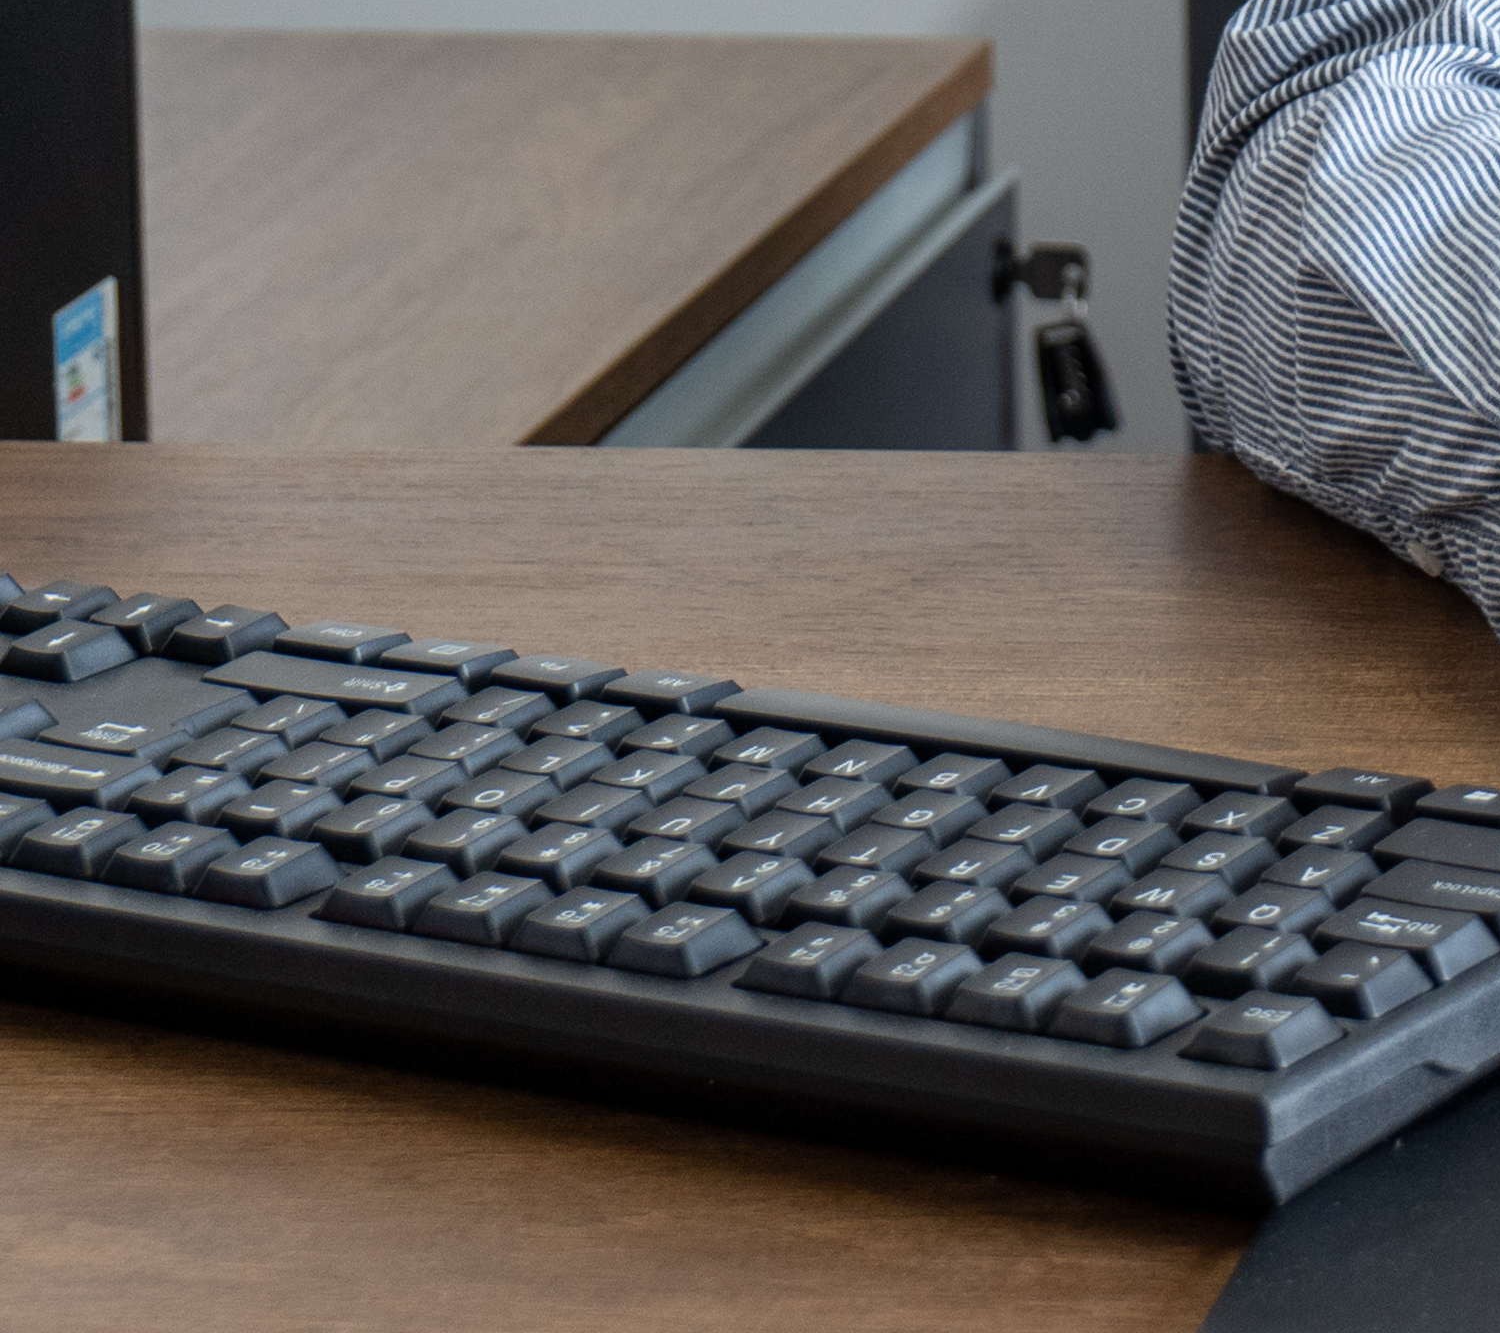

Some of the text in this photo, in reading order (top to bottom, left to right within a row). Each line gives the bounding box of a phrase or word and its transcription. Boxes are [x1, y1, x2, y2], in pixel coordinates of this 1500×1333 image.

[737, 745, 775, 760] M
[540, 755, 562, 770] L
[833, 759, 868, 773] N
[384, 775, 417, 789] P
[620, 769, 654, 783] K
[928, 771, 959, 786] B
[472, 788, 506, 804] O
[716, 784, 746, 796] J
[1021, 784, 1049, 798] V
[377, 803, 401, 816] 0
[806, 796, 841, 810] H
[1118, 797, 1146, 811] C
[903, 809, 934, 823] G
[1215, 811, 1247, 825] X
[471, 817, 497, 830] 9
[659, 817, 692, 832] U
[50, 824, 89, 840] F11
[564, 832, 588, 844] 8
[754, 832, 784, 846] Y
[999, 825, 1031, 839] F
[1312, 825, 1345, 840] Z
[140, 841, 183, 855] F10
[1097, 837, 1129, 852] D
[659, 846, 685, 859] 7
[850, 847, 878, 861] T
[1197, 852, 1226, 867] S
[239, 857, 276, 870] F9
[754, 860, 779, 874] 6
[950, 861, 982, 875] R
[1302, 866, 1330, 881] A
[364, 878, 401, 891] F8
[1047, 874, 1080, 889] E
[457, 895, 494, 906] F7
[954, 890, 976, 901] 4
[1135, 887, 1175, 903] W
[555, 909, 592, 922] F6
[1249, 903, 1280, 921] Q
[653, 925, 690, 938] F5
[1152, 920, 1179, 933] 2
[1402, 921, 1443, 934] Tab
[790, 947, 826, 961] F4
[891, 963, 927, 977] F3
[994, 976, 1031, 994] F2
[1101, 993, 1137, 1009] F1
[1244, 1007, 1292, 1023] ESC
